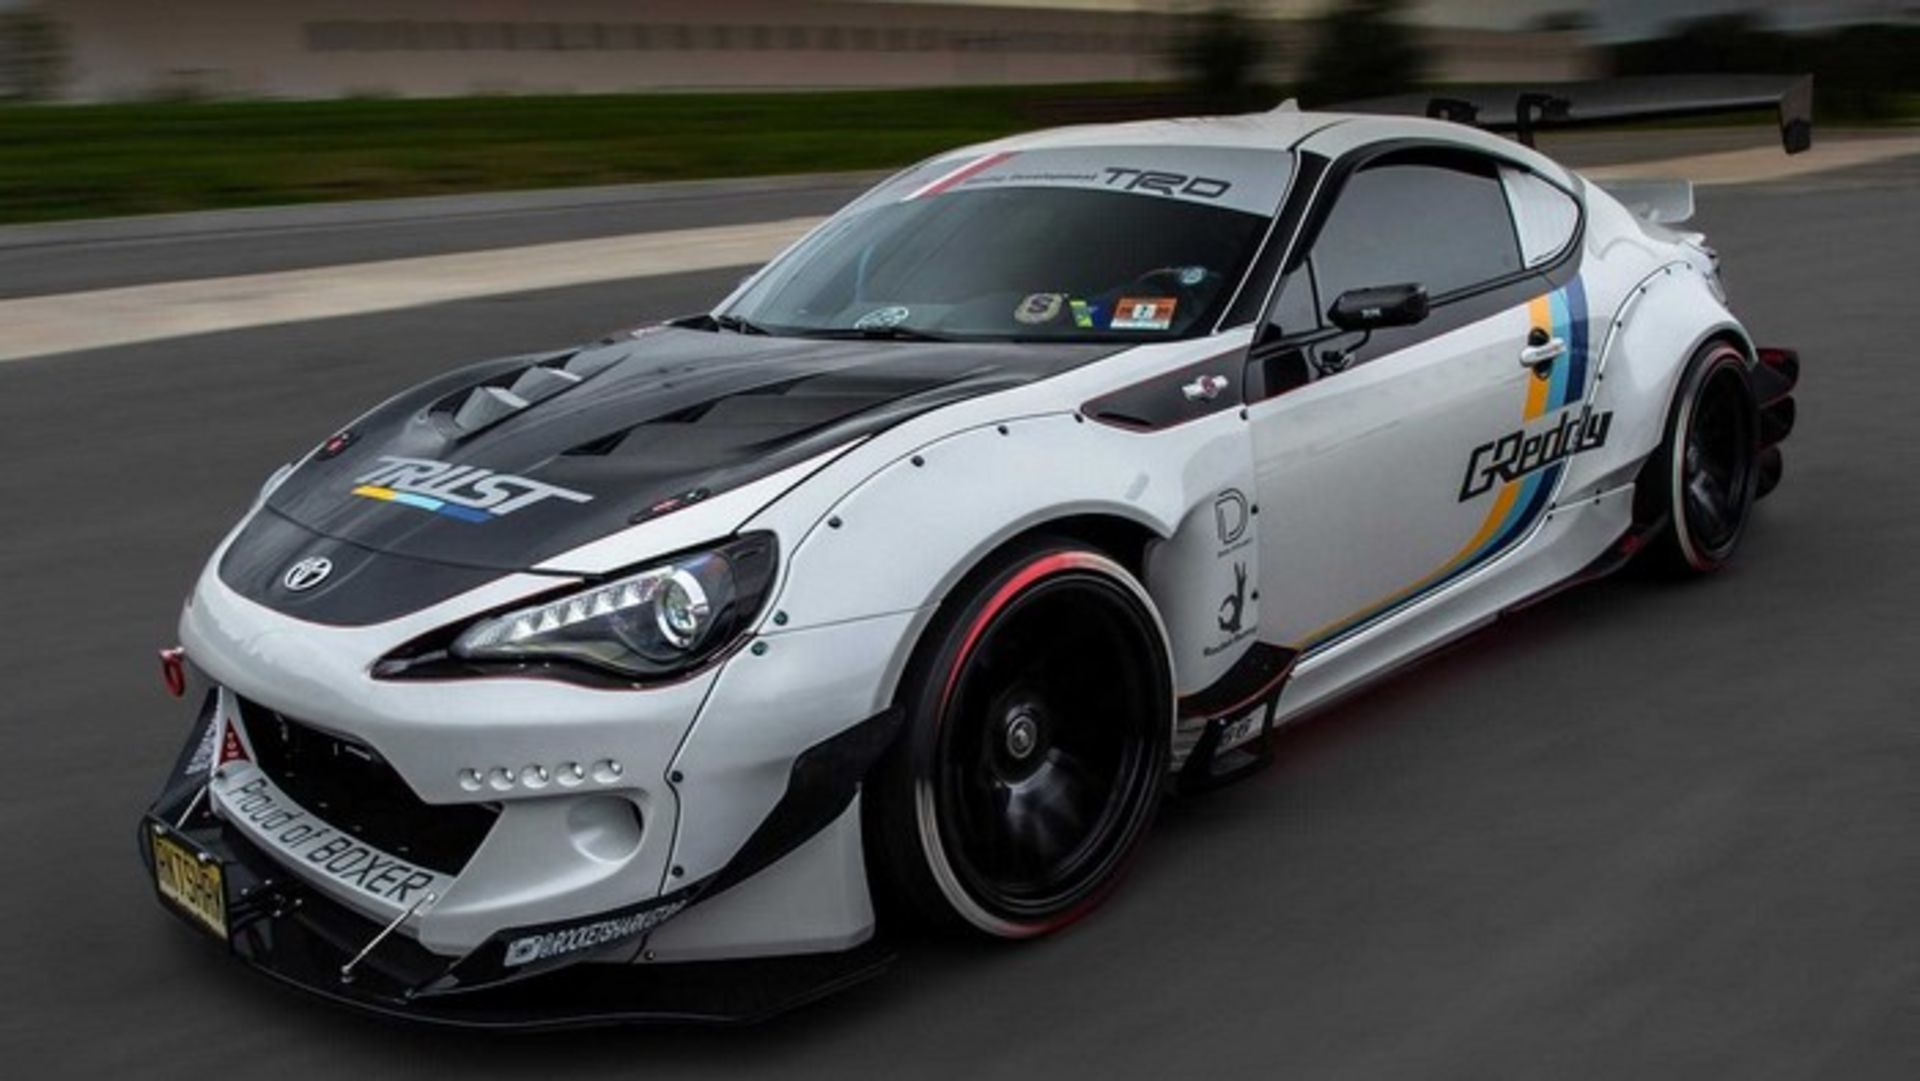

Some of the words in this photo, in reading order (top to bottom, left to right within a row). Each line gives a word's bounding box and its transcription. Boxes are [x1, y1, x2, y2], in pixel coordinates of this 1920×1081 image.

[1104, 167, 1232, 198] TRD
[353, 455, 595, 516] TRUST
[225, 777, 304, 832] Proud
[279, 825, 331, 848] of
[306, 836, 435, 903] BOXER
